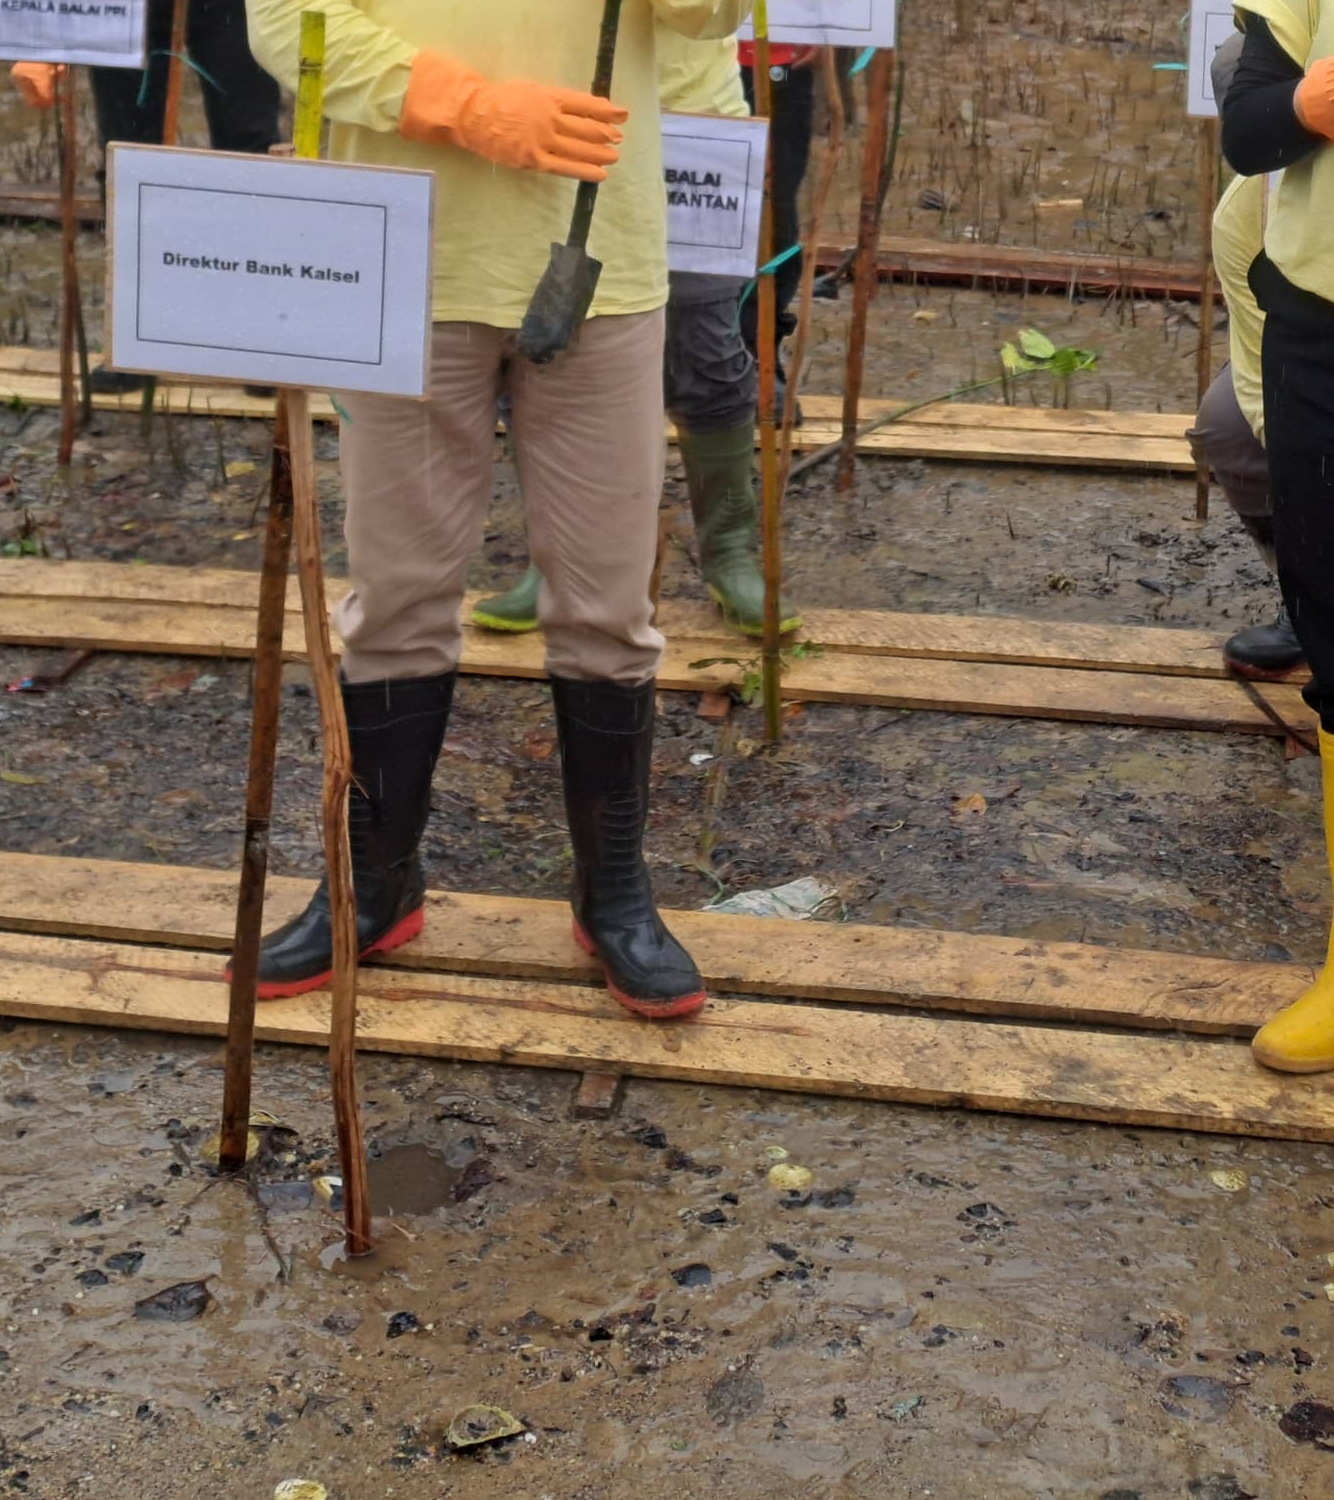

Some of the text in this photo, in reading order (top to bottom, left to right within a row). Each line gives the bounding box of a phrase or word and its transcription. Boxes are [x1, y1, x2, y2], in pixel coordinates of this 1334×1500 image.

[58, 2, 101, 16] BALAI
[664, 167, 721, 188] BALAI
[163, 252, 361, 285] Direktur Bank Kalsel
